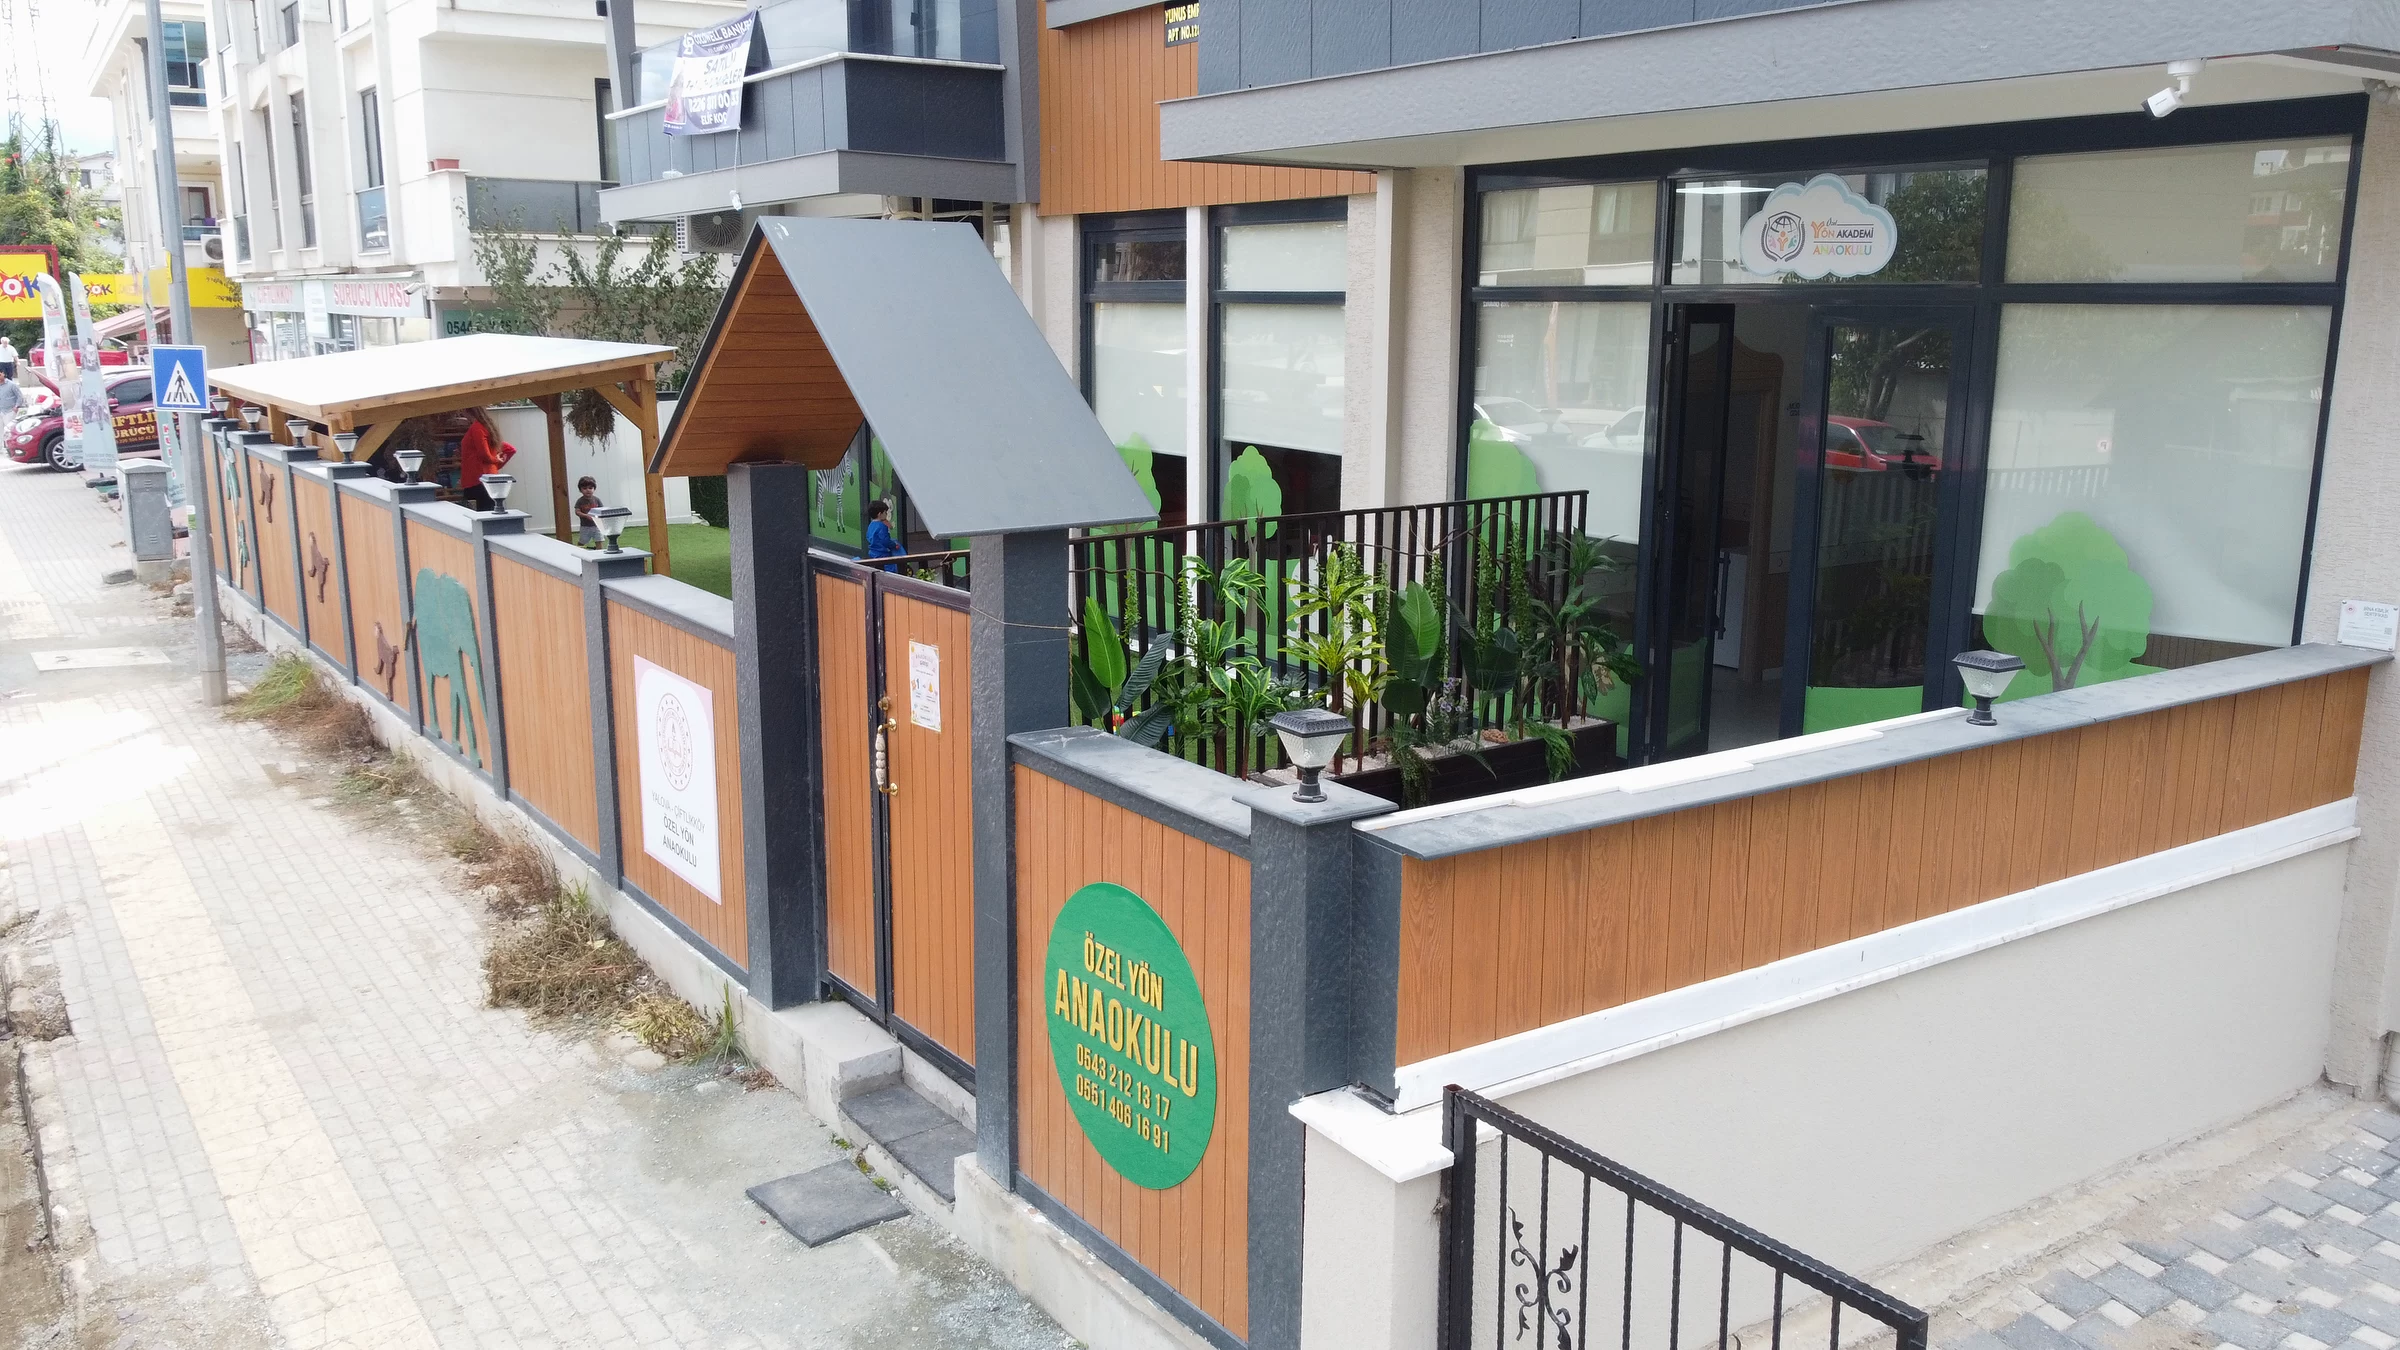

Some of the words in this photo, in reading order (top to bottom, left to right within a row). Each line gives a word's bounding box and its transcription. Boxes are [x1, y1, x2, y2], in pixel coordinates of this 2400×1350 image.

[1168, 27, 1179, 42] APT
[1811, 221, 1835, 238] YÖN
[1836, 227, 1874, 238] AKADEMİ
[1813, 244, 1872, 255] ANAOKULU
[663, 813, 680, 836] ÖZEL
[680, 826, 694, 846] YÖN
[663, 835, 697, 868] ANAOKULU
[1083, 930, 1125, 991] ÖZEL
[1127, 960, 1163, 1011] YÖN
[1055, 968, 1199, 1097] ANAOKULU
[1076, 1043, 1106, 1080] 0543
[1109, 1063, 1133, 1098] 212
[1136, 1080, 1152, 1110] 13
[1156, 1093, 1171, 1121] 17
[1076, 1073, 1106, 1111] 0551
[1108, 1095, 1133, 1129] 406
[1136, 1113, 1151, 1142] 16
[1153, 1121, 1170, 1154] 91
